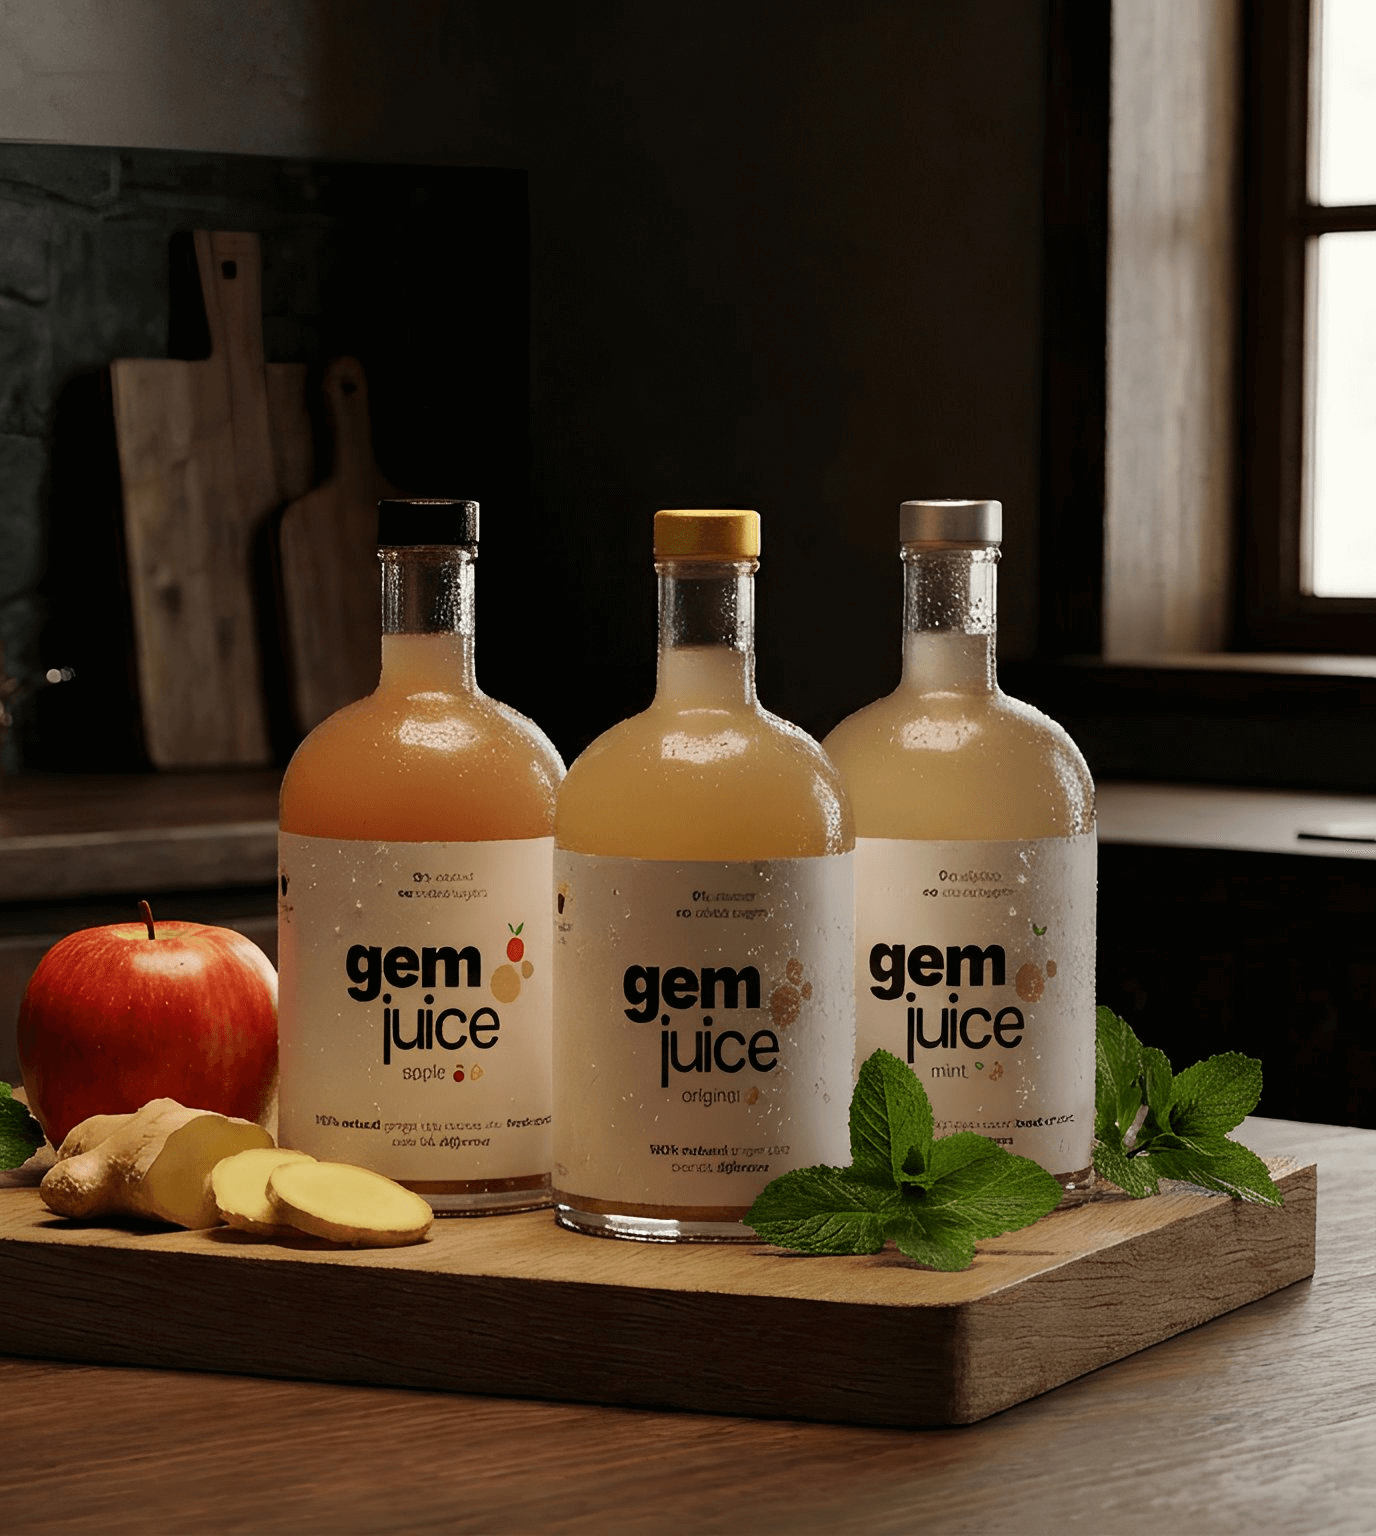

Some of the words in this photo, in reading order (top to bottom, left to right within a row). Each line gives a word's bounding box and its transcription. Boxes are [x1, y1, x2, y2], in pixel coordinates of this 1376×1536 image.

[346, 944, 481, 1002] gem
[623, 965, 761, 1023] gem
[869, 943, 1006, 1000] gem
[383, 993, 500, 1065] juice
[661, 1014, 780, 1088] juice
[906, 992, 1024, 1064] juice
[682, 1088, 741, 1108] original
[931, 1064, 969, 1079] mint
